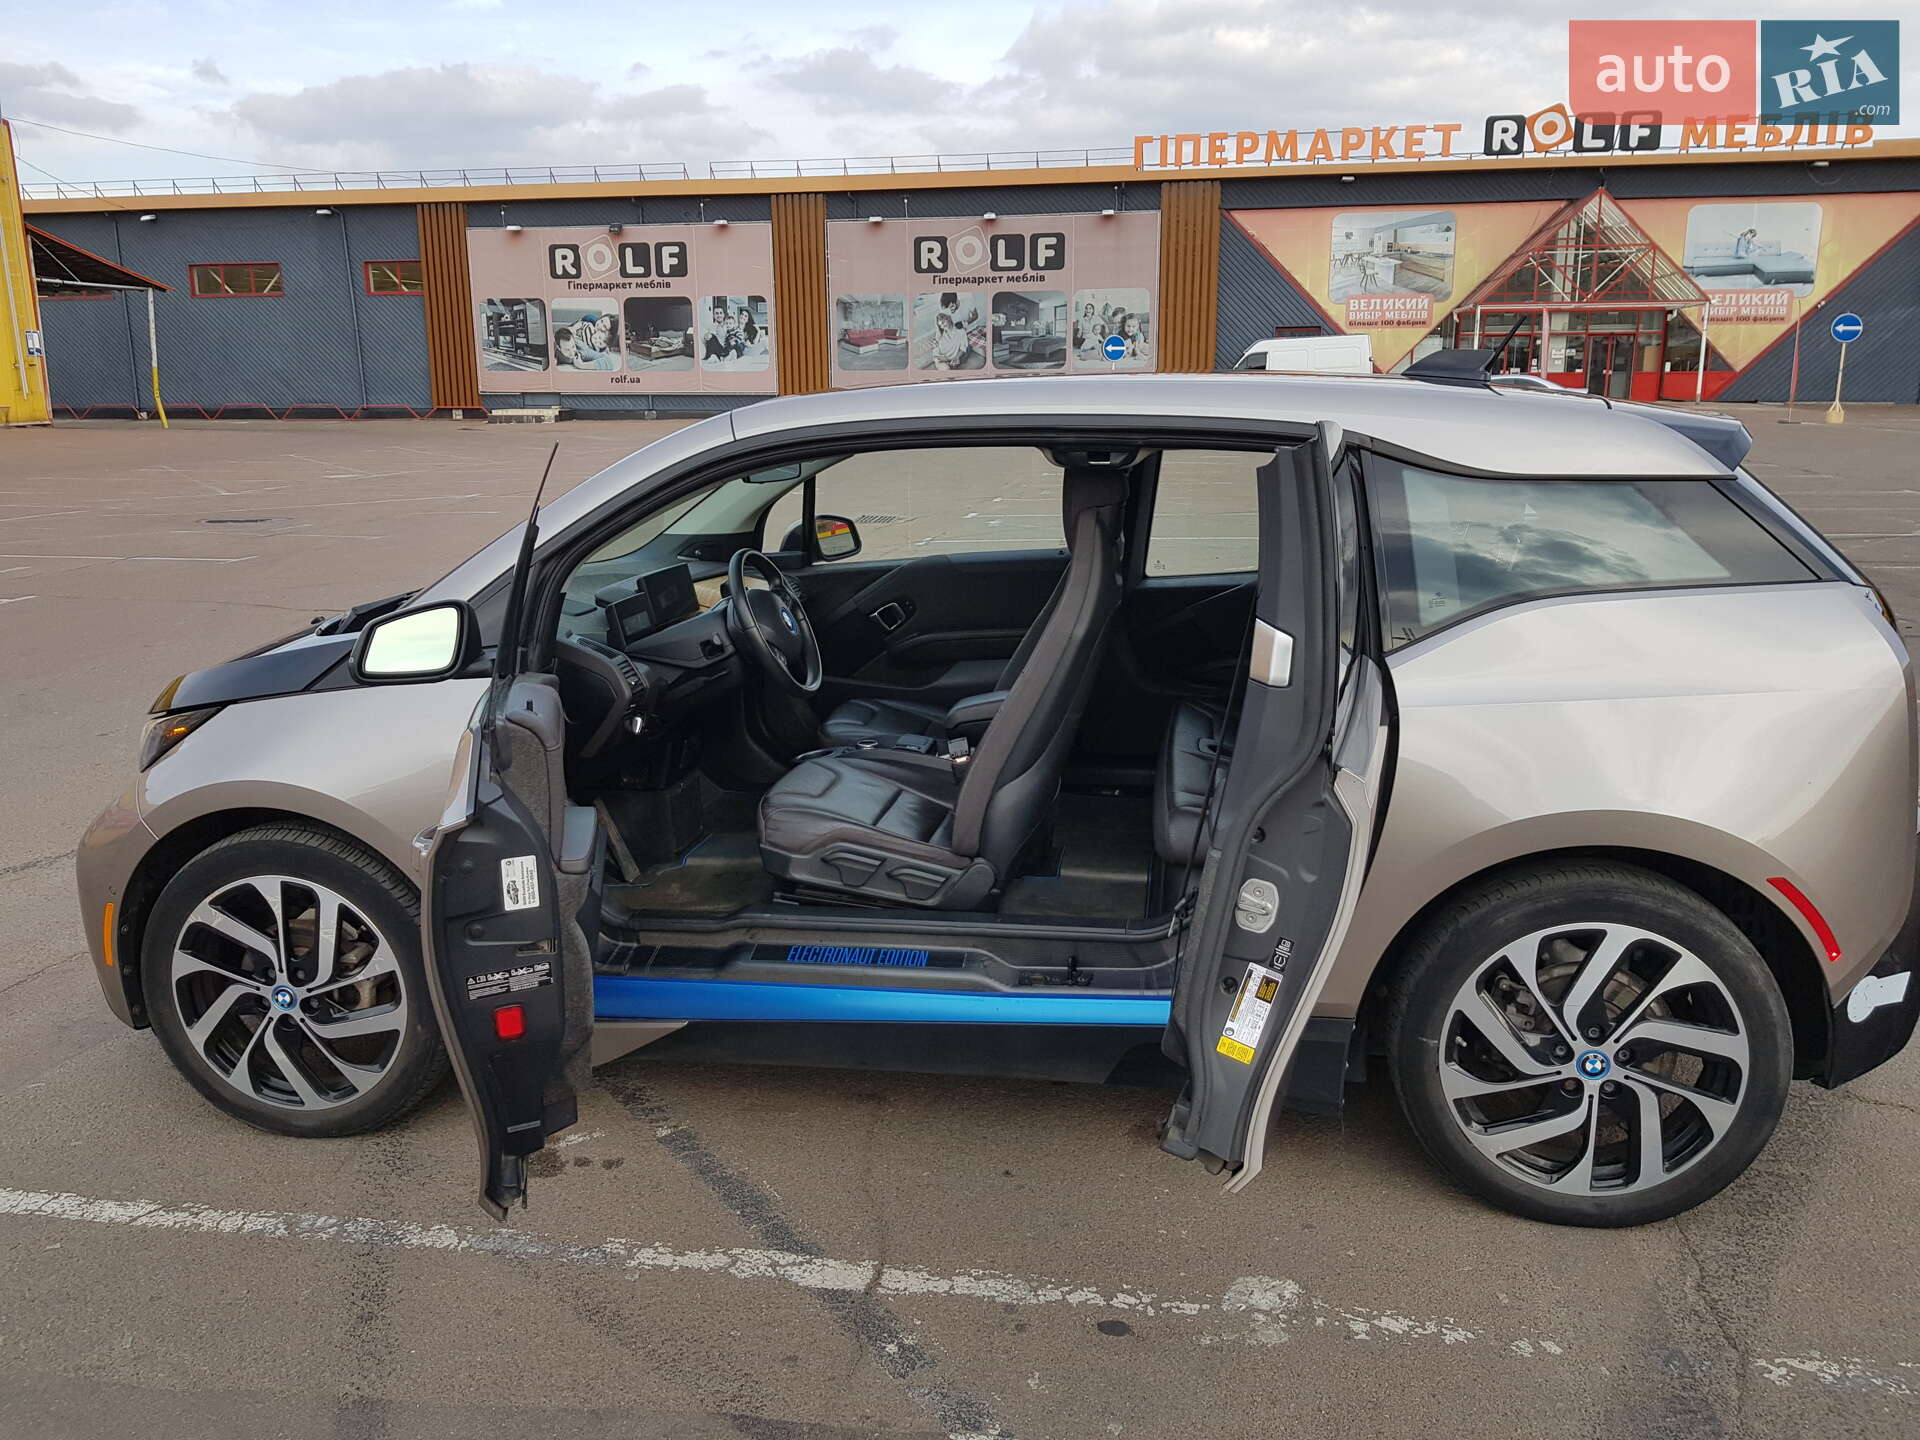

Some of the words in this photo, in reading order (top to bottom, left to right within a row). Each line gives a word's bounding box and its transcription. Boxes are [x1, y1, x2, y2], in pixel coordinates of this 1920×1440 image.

[1134, 123, 1462, 168] ГІПЕРМАРКЕТ
[1489, 112, 1657, 152] ROLF
[1679, 110, 1874, 150] МЕБЛІВ
[552, 240, 683, 277] ROLF
[918, 233, 1061, 271] ROLF
[567, 280, 632, 291] Гіпермаркет
[635, 280, 671, 289] меблів
[932, 274, 1004, 286] Гіпермаркет
[1006, 273, 1046, 283] меблів
[1349, 295, 1430, 310] ВЕЛИКИЙ
[1708, 290, 1789, 305] ЕЛИКИЙ
[1349, 311, 1381, 320] ВИБІР
[1385, 310, 1428, 319] МЕБЛІВ
[1740, 306, 1787, 315] МЕБЛІВ
[610, 374, 641, 384] rolf.ua
[787, 945, 876, 964] ELECTRONAUT
[877, 949, 929, 967] EDITION
